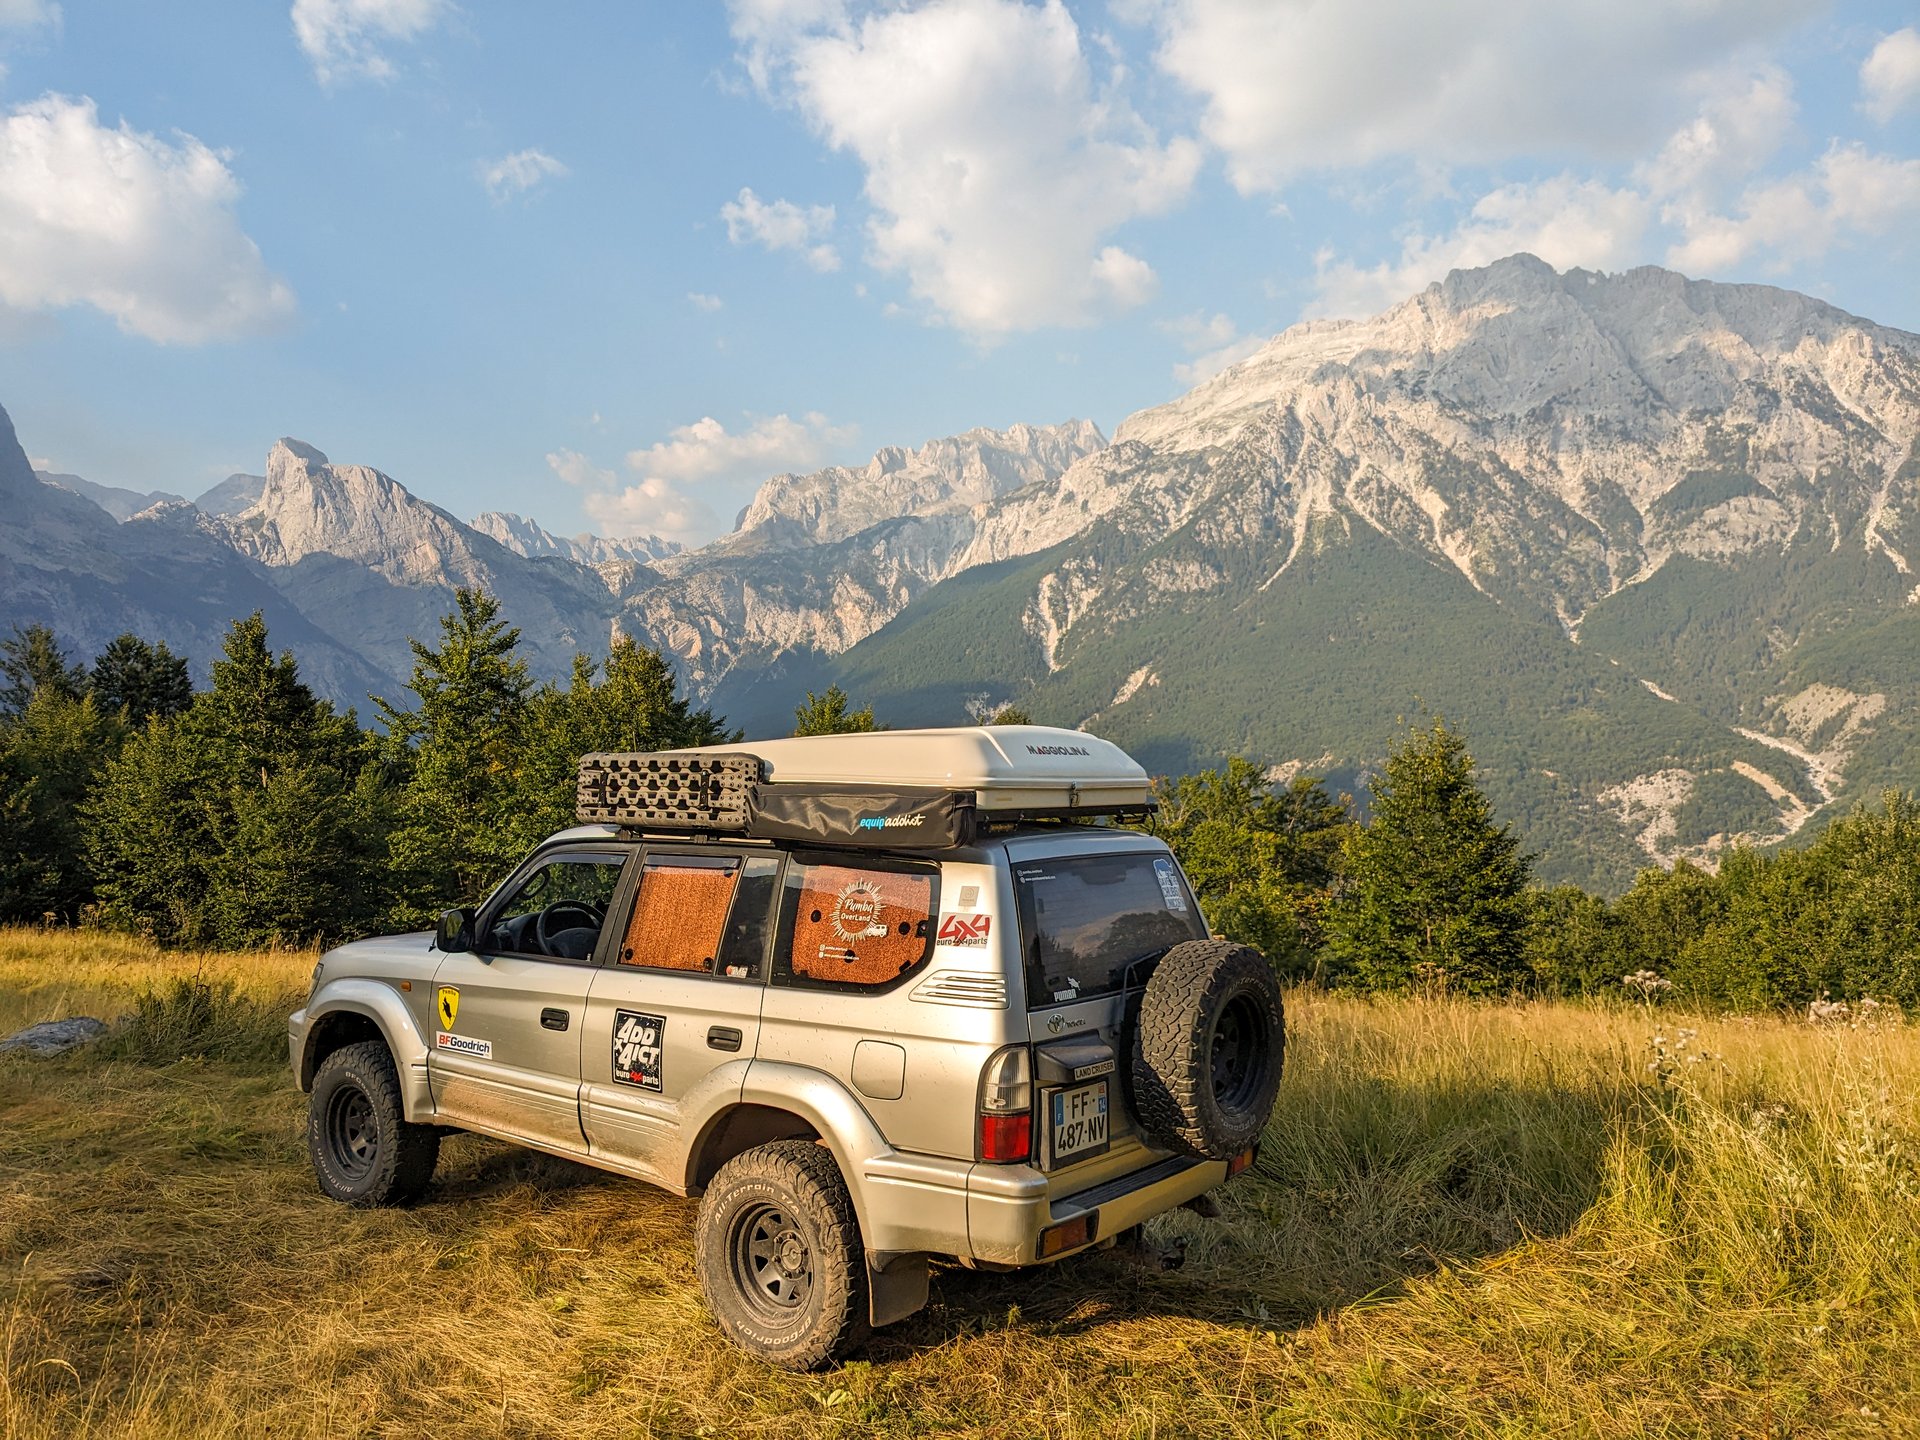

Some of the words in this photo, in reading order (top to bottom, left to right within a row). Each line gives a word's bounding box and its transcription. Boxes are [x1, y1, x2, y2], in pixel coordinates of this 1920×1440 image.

[1025, 744, 1090, 756] MAGGIOLINA
[844, 899, 874, 913] Pumba
[840, 912, 871, 922] OverLand
[439, 1034, 490, 1053] BFGoodrich
[1075, 1067, 1092, 1079] LAND
[1091, 1061, 1114, 1075] CRUISER
[1071, 1091, 1090, 1119] FF
[714, 1183, 775, 1225] All-Terrain
[781, 1191, 800, 1215] T/A
[736, 1315, 812, 1345] BFGoodrich
